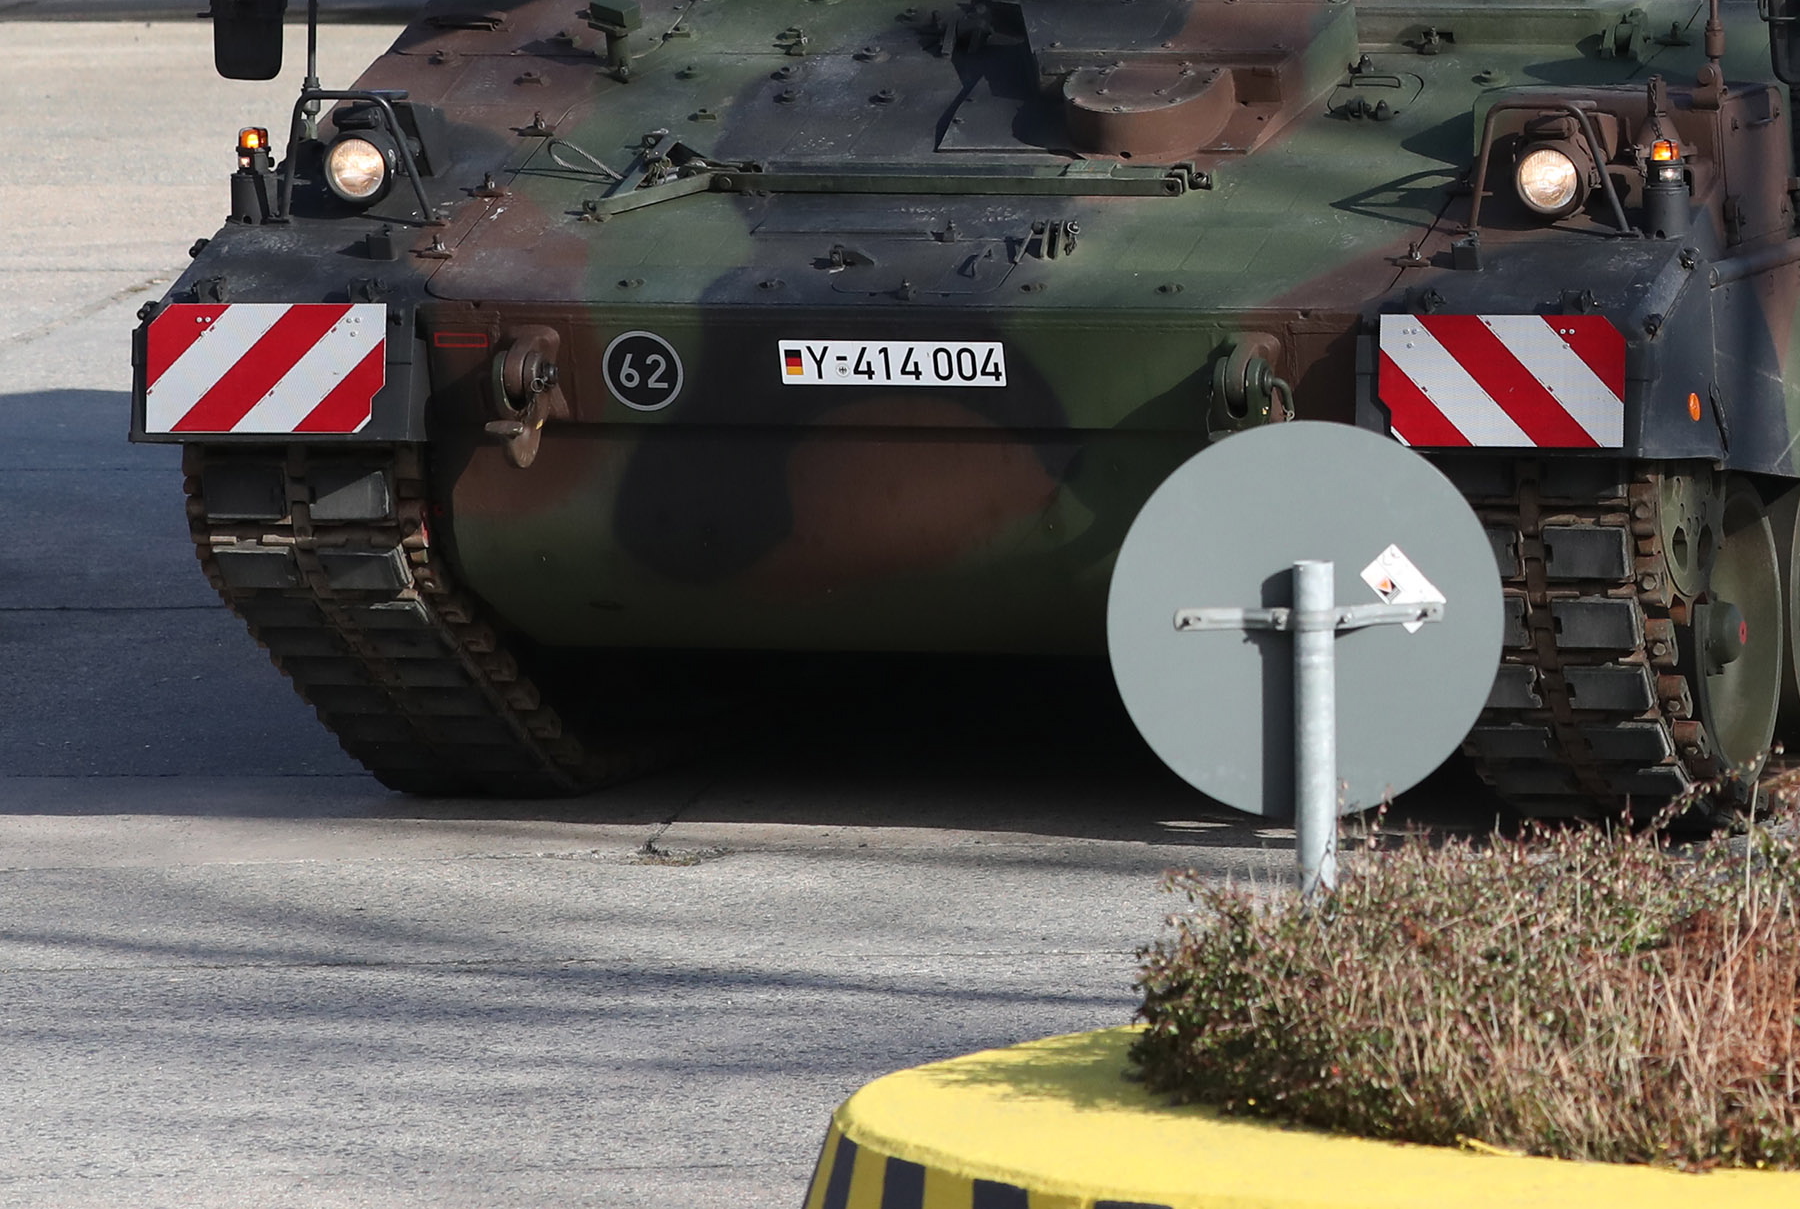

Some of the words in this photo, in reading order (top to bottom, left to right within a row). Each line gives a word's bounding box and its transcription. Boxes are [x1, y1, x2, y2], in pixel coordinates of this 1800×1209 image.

[618, 353, 669, 389] 62
[805, 345, 923, 381] Y-414
[932, 347, 1002, 382] 004
